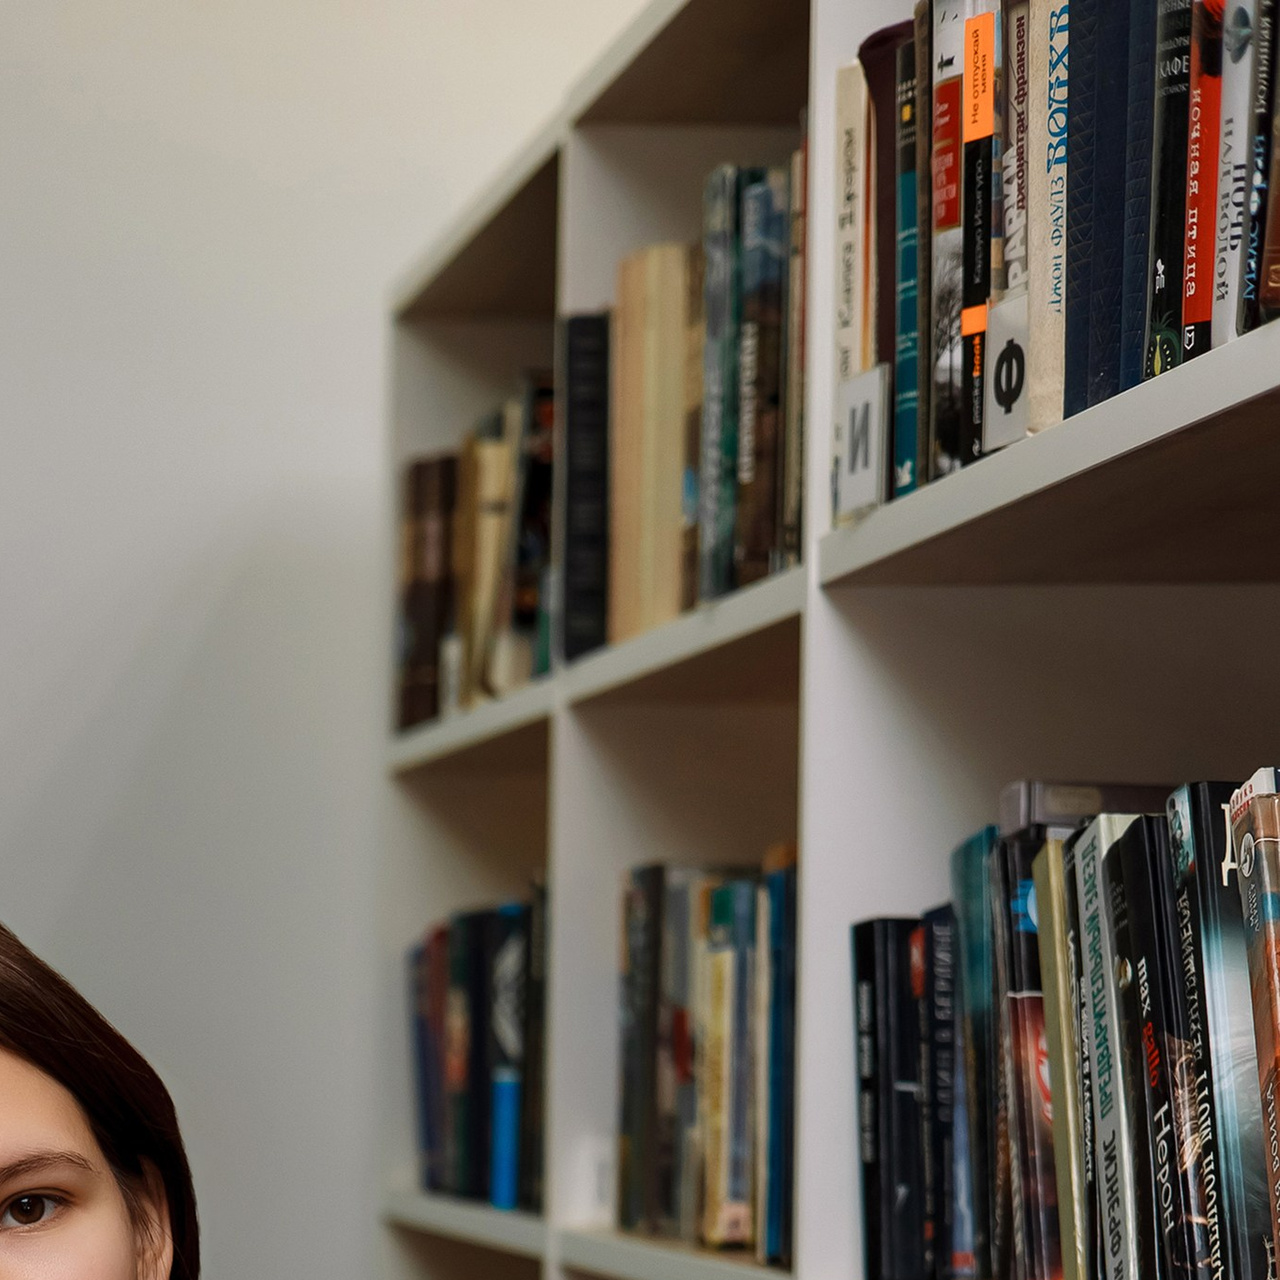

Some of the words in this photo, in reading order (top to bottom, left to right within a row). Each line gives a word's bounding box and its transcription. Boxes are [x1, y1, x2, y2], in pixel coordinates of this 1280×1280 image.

[971, 28, 981, 98] отпускай
[1013, 15, 1026, 106] франзен
[1047, 4, 1070, 174] ВОЛХВ
[970, 102, 980, 125] Не
[1048, 176, 1065, 247] ФАУЛЗ
[1242, 220, 1260, 301] Макс
[993, 338, 1026, 416] Ф
[848, 400, 869, 475] И
[1081, 835, 1100, 914] ЗАЕЗД
[1087, 919, 1115, 1120] ПРЕДВАРИТЕЛЬНЫЙ
[1136, 957, 1153, 1018] max
[1142, 1021, 1161, 1088] gallo
[1194, 1069, 1213, 1142] МОТТ
[1101, 1129, 1122, 1259] ФРЭНСИС
